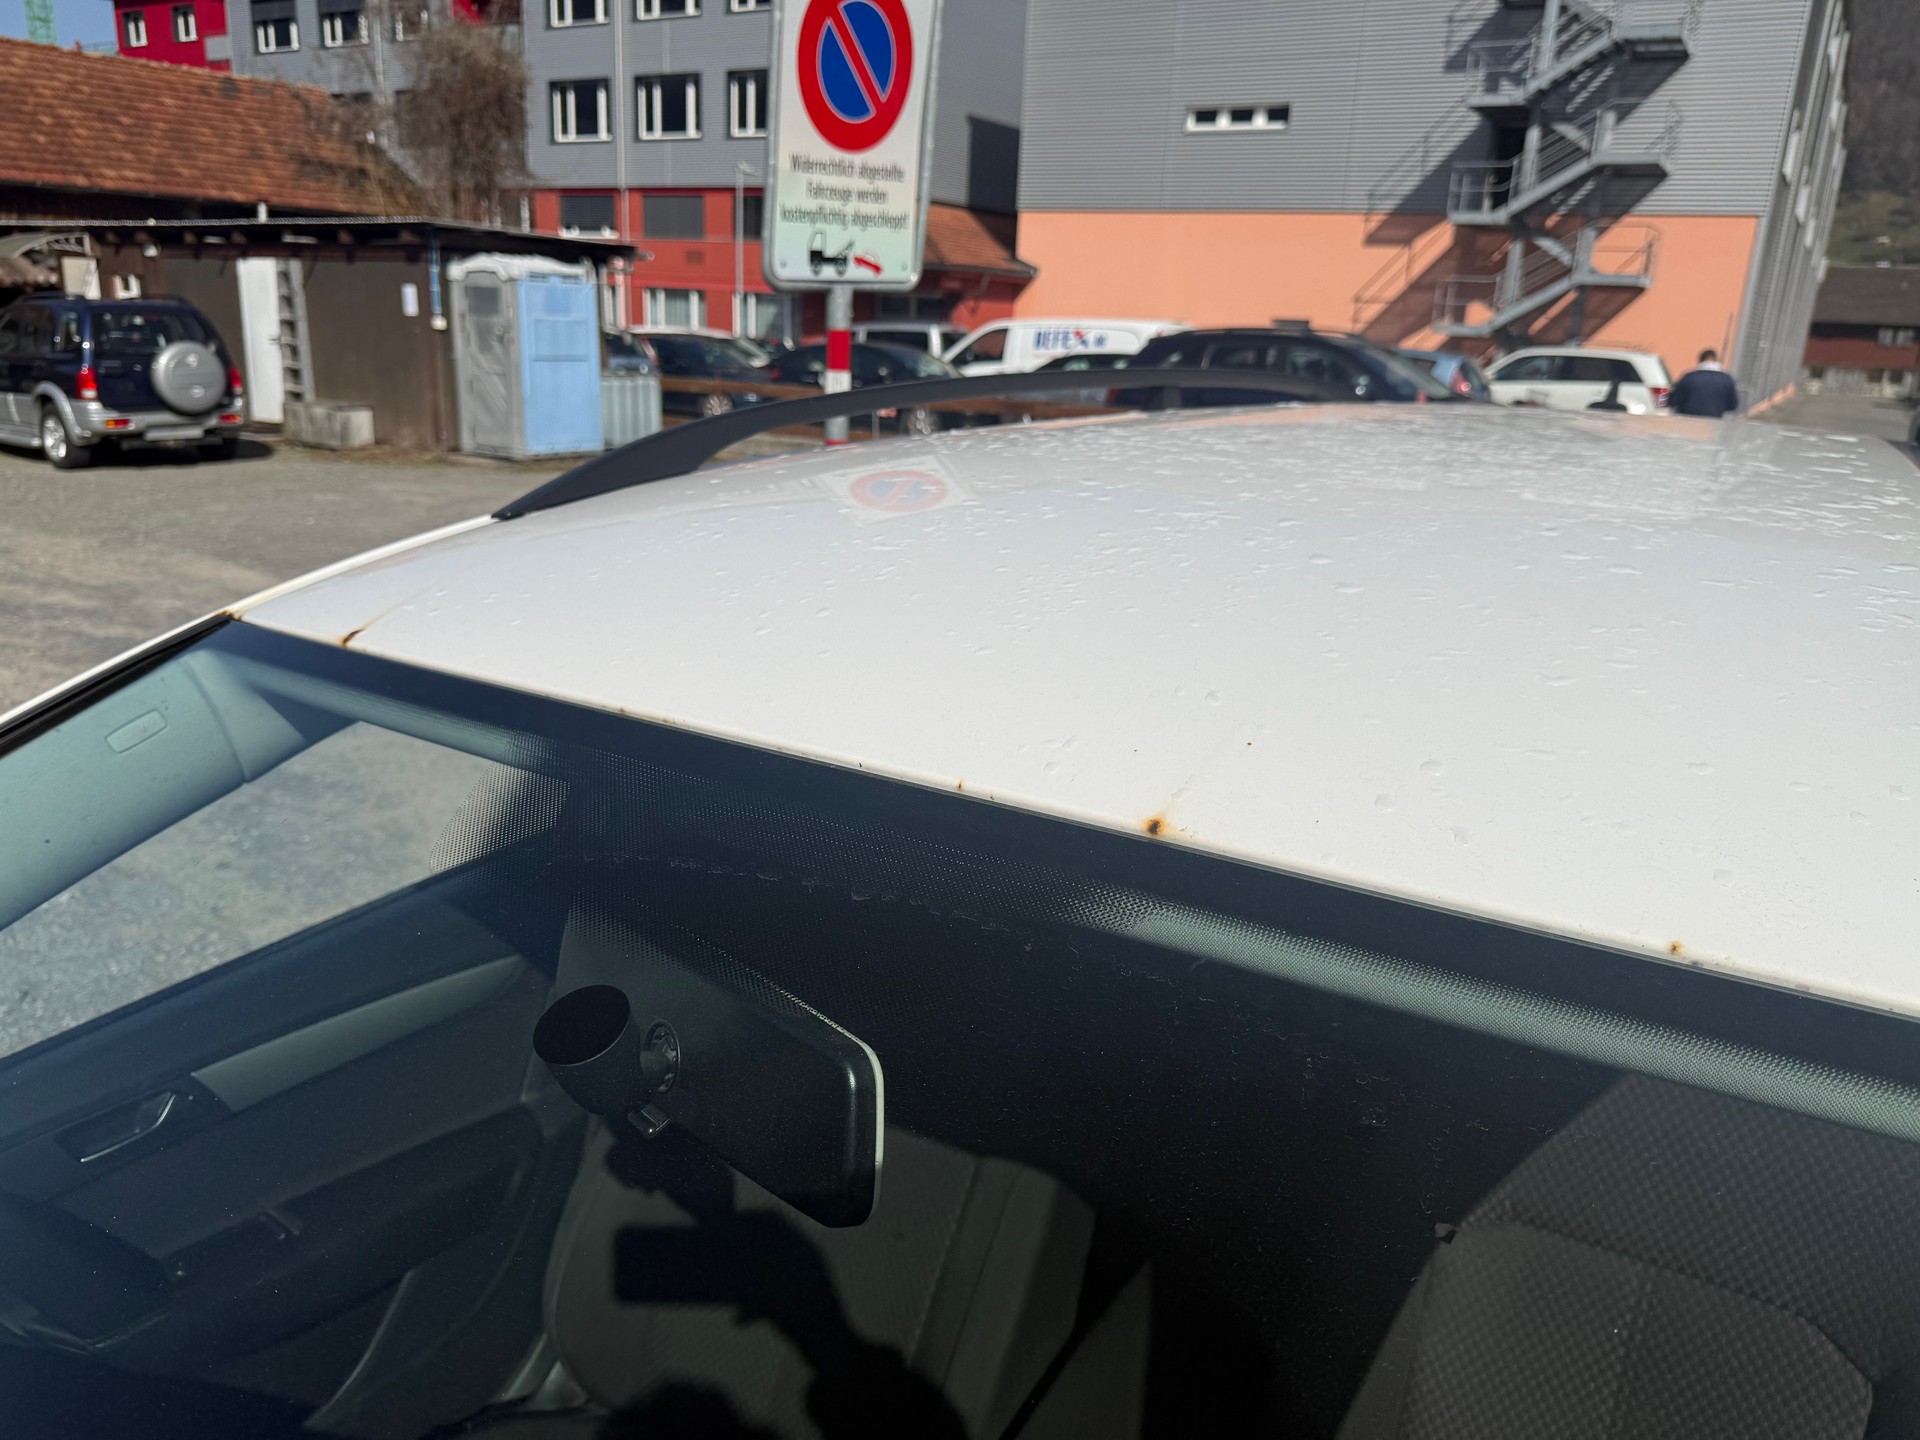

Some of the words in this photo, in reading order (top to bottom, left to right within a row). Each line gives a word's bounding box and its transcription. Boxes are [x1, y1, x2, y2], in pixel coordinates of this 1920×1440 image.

[790, 153, 854, 177] Widerrechtlich
[859, 161, 904, 184] abgestellte
[806, 180, 853, 206] Fahrzeuge
[857, 186, 887, 204] werden
[780, 204, 848, 231] kostenpflichtig
